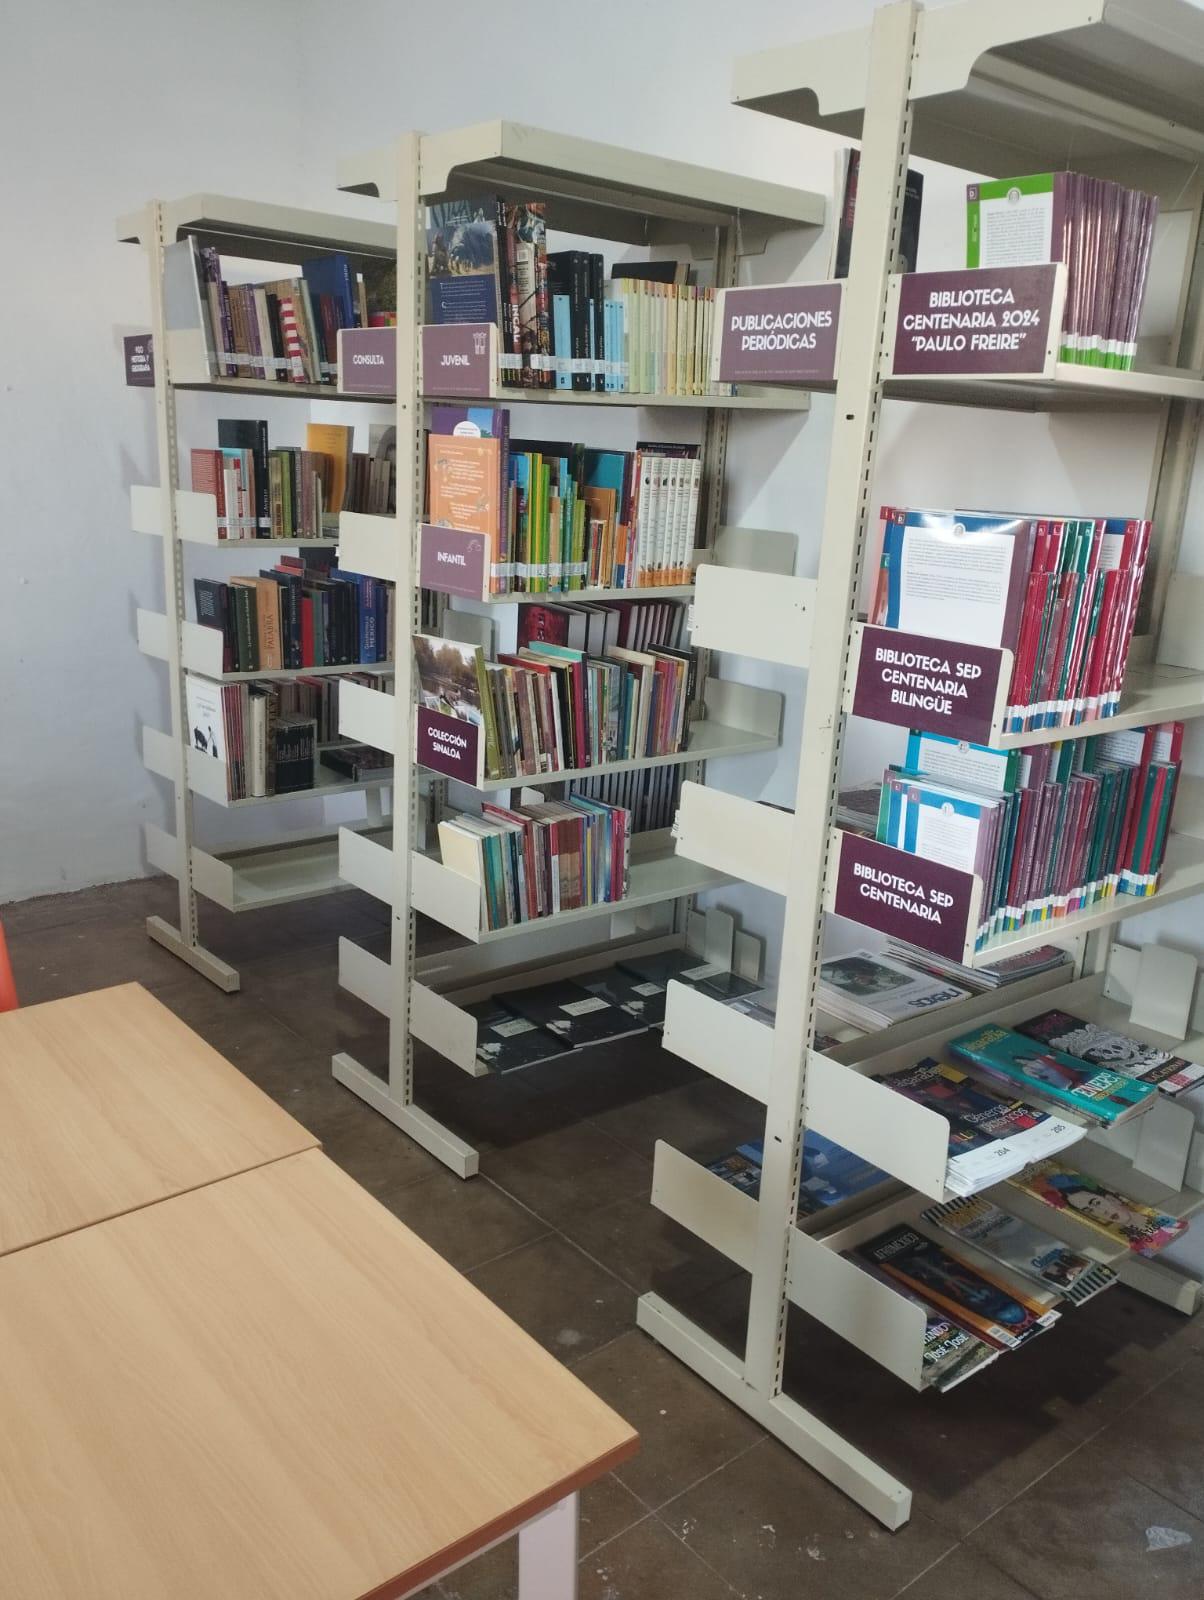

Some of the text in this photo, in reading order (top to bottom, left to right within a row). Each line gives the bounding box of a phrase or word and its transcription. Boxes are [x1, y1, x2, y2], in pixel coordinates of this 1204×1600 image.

[929, 287, 1015, 307] BIBLIOTECA
[731, 311, 833, 332] PUBLICACIONES
[903, 308, 1040, 330] CENTENARIA 2024
[741, 329, 816, 351] PERIÓDICAS
[352, 354, 385, 365] CONSULTA
[440, 354, 470, 367] JUVENIL
[437, 551, 467, 567] INFANTIL
[875, 647, 982, 680] BIBLIOTECA SEP
[881, 668, 969, 699] CENTENARIA
[890, 688, 953, 716] BILINGÜE
[427, 726, 467, 749] COLECCIÓN
[432, 742, 461, 760] SINALOA
[853, 862, 954, 908] BIBLIOTECA SEP
[859, 884, 942, 925] CENTENARIA
